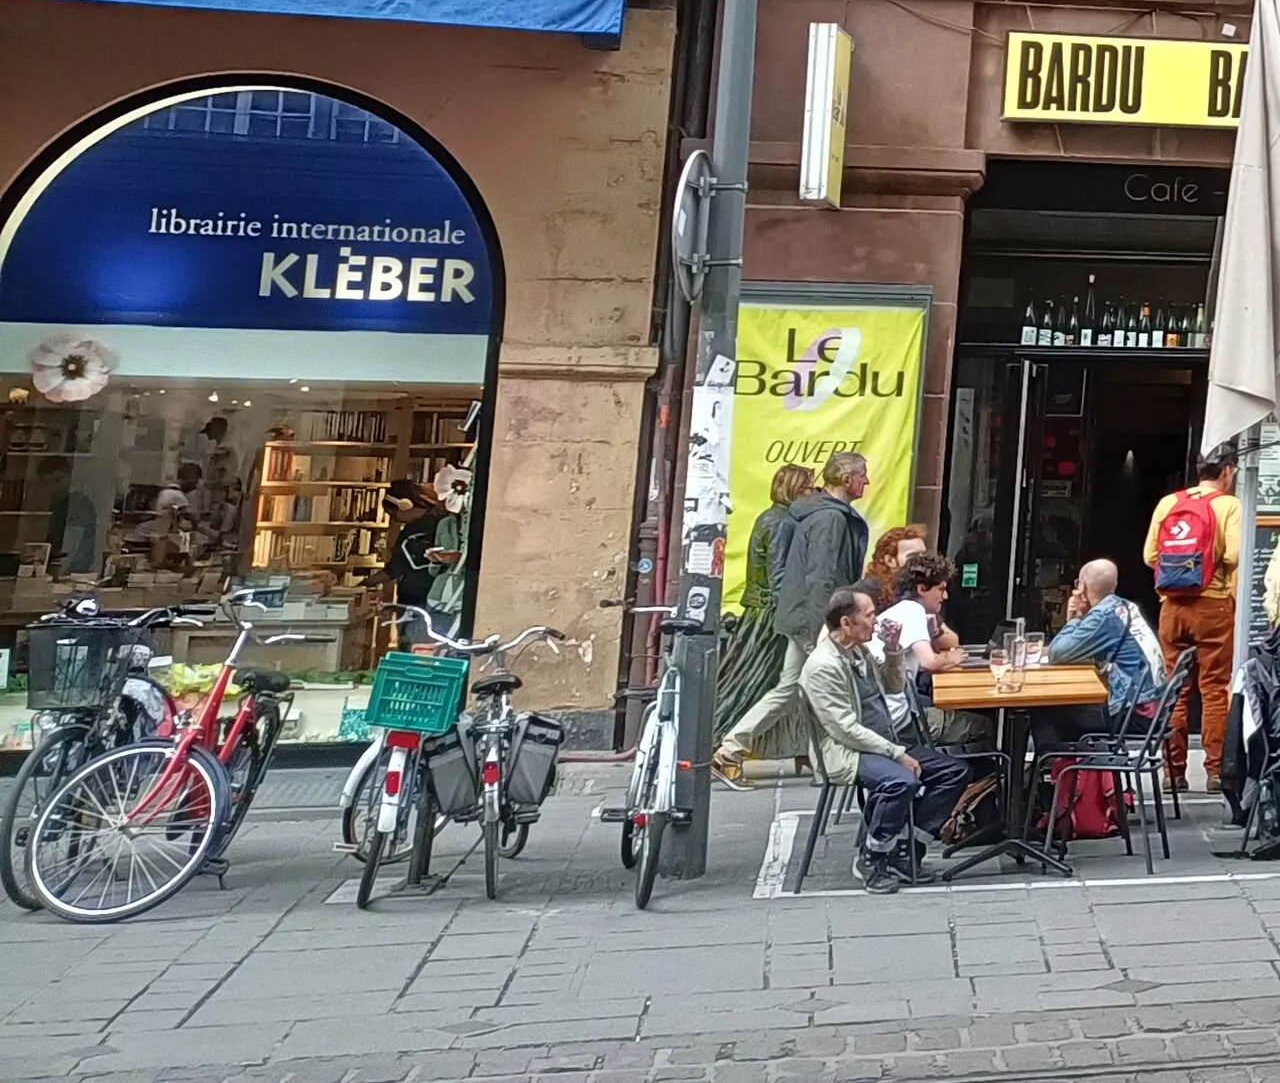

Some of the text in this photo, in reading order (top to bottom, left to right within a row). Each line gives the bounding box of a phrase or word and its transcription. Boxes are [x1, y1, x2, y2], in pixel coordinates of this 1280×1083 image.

[1016, 40, 1145, 115] BARDU
[1123, 173, 1200, 203] Café
[148, 208, 466, 246] librairie internationale
[786, 327, 843, 364] Le
[733, 360, 905, 398] Bardu
